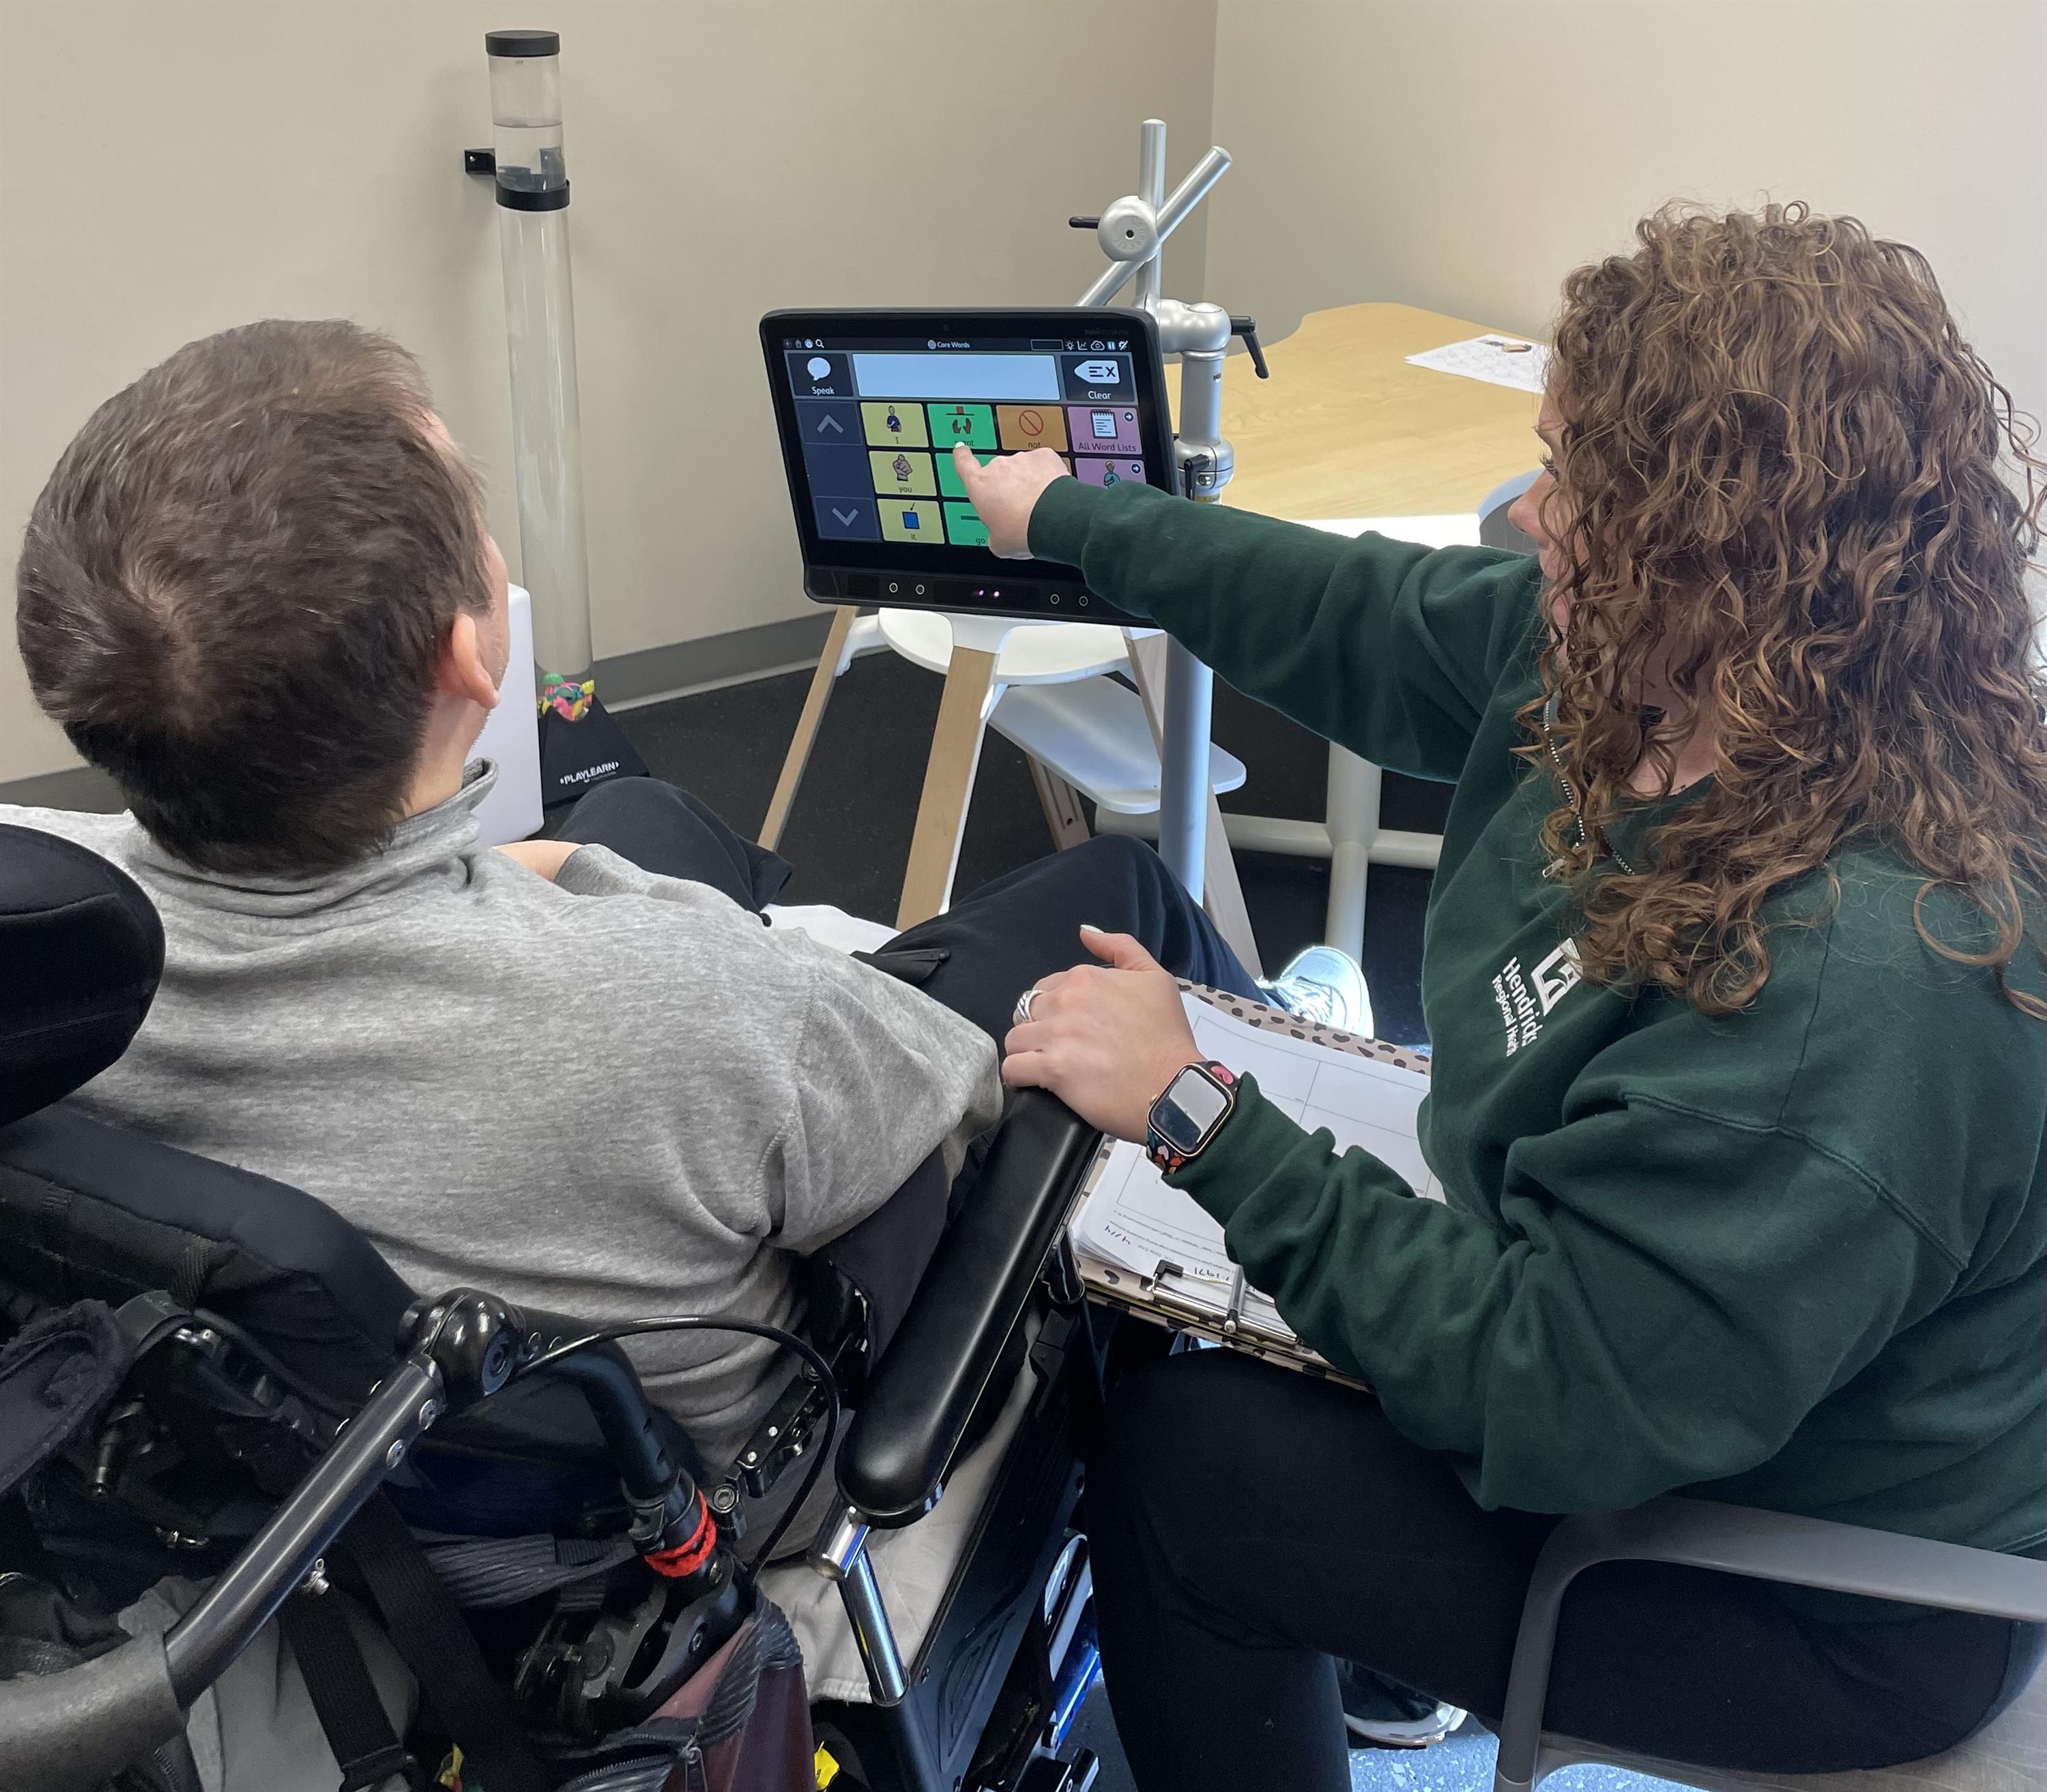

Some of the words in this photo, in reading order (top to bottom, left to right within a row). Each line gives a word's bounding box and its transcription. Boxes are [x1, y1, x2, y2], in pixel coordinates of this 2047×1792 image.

[811, 386, 835, 396] Speak
[1088, 390, 1112, 400] Clear
[1078, 442, 1090, 451] All
[1092, 442, 1116, 452] Word
[1117, 443, 1137, 452] Lists
[563, 761, 615, 784] PLAYLEARN
[1502, 956, 1543, 1048] Hendricks
[1492, 973, 1517, 1027] Regional
[1506, 1025, 1520, 1057] Health
